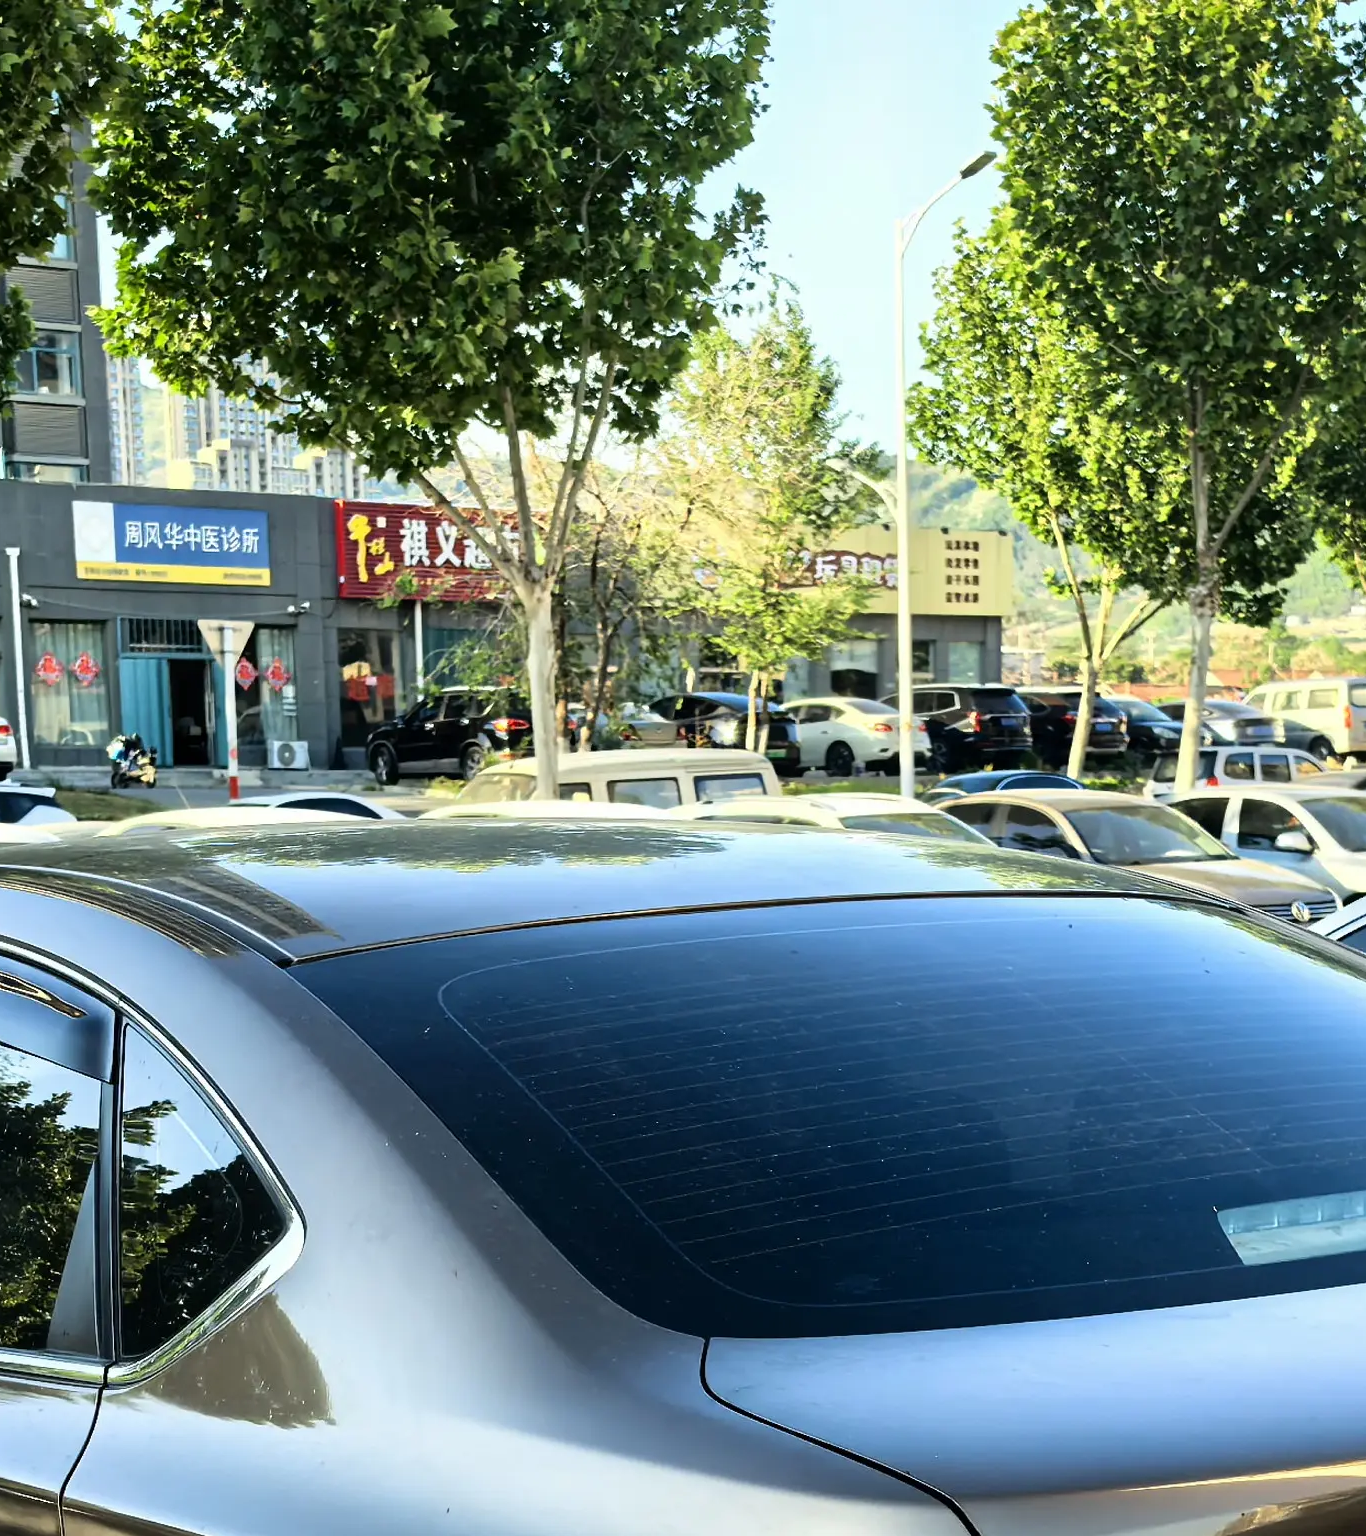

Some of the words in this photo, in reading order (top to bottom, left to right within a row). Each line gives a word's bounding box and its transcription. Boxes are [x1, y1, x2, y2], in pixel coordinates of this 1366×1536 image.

[124, 511, 260, 554] 周风华中医诊所
